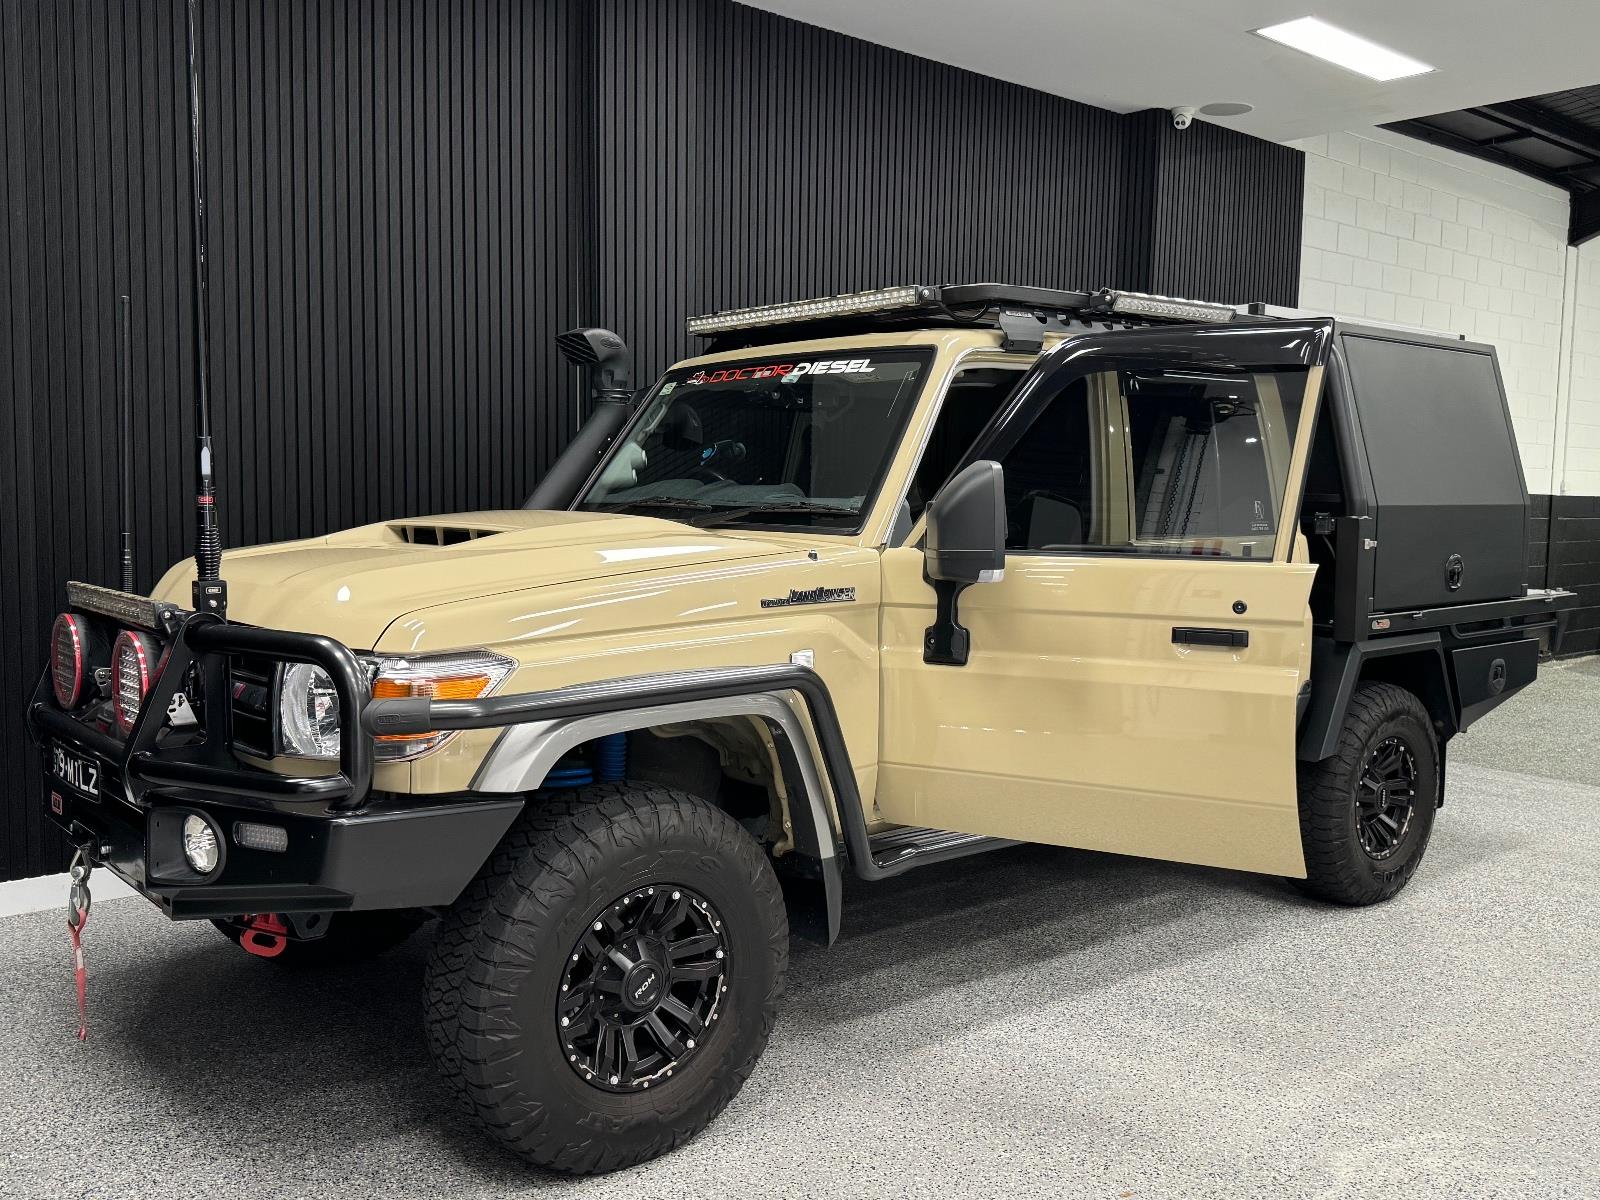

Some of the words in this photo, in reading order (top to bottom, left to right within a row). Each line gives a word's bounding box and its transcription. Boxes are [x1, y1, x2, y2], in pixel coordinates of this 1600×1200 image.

[709, 364, 795, 383] DOCTOR
[793, 359, 876, 376] DIESEL
[634, 973, 655, 998] ROH
